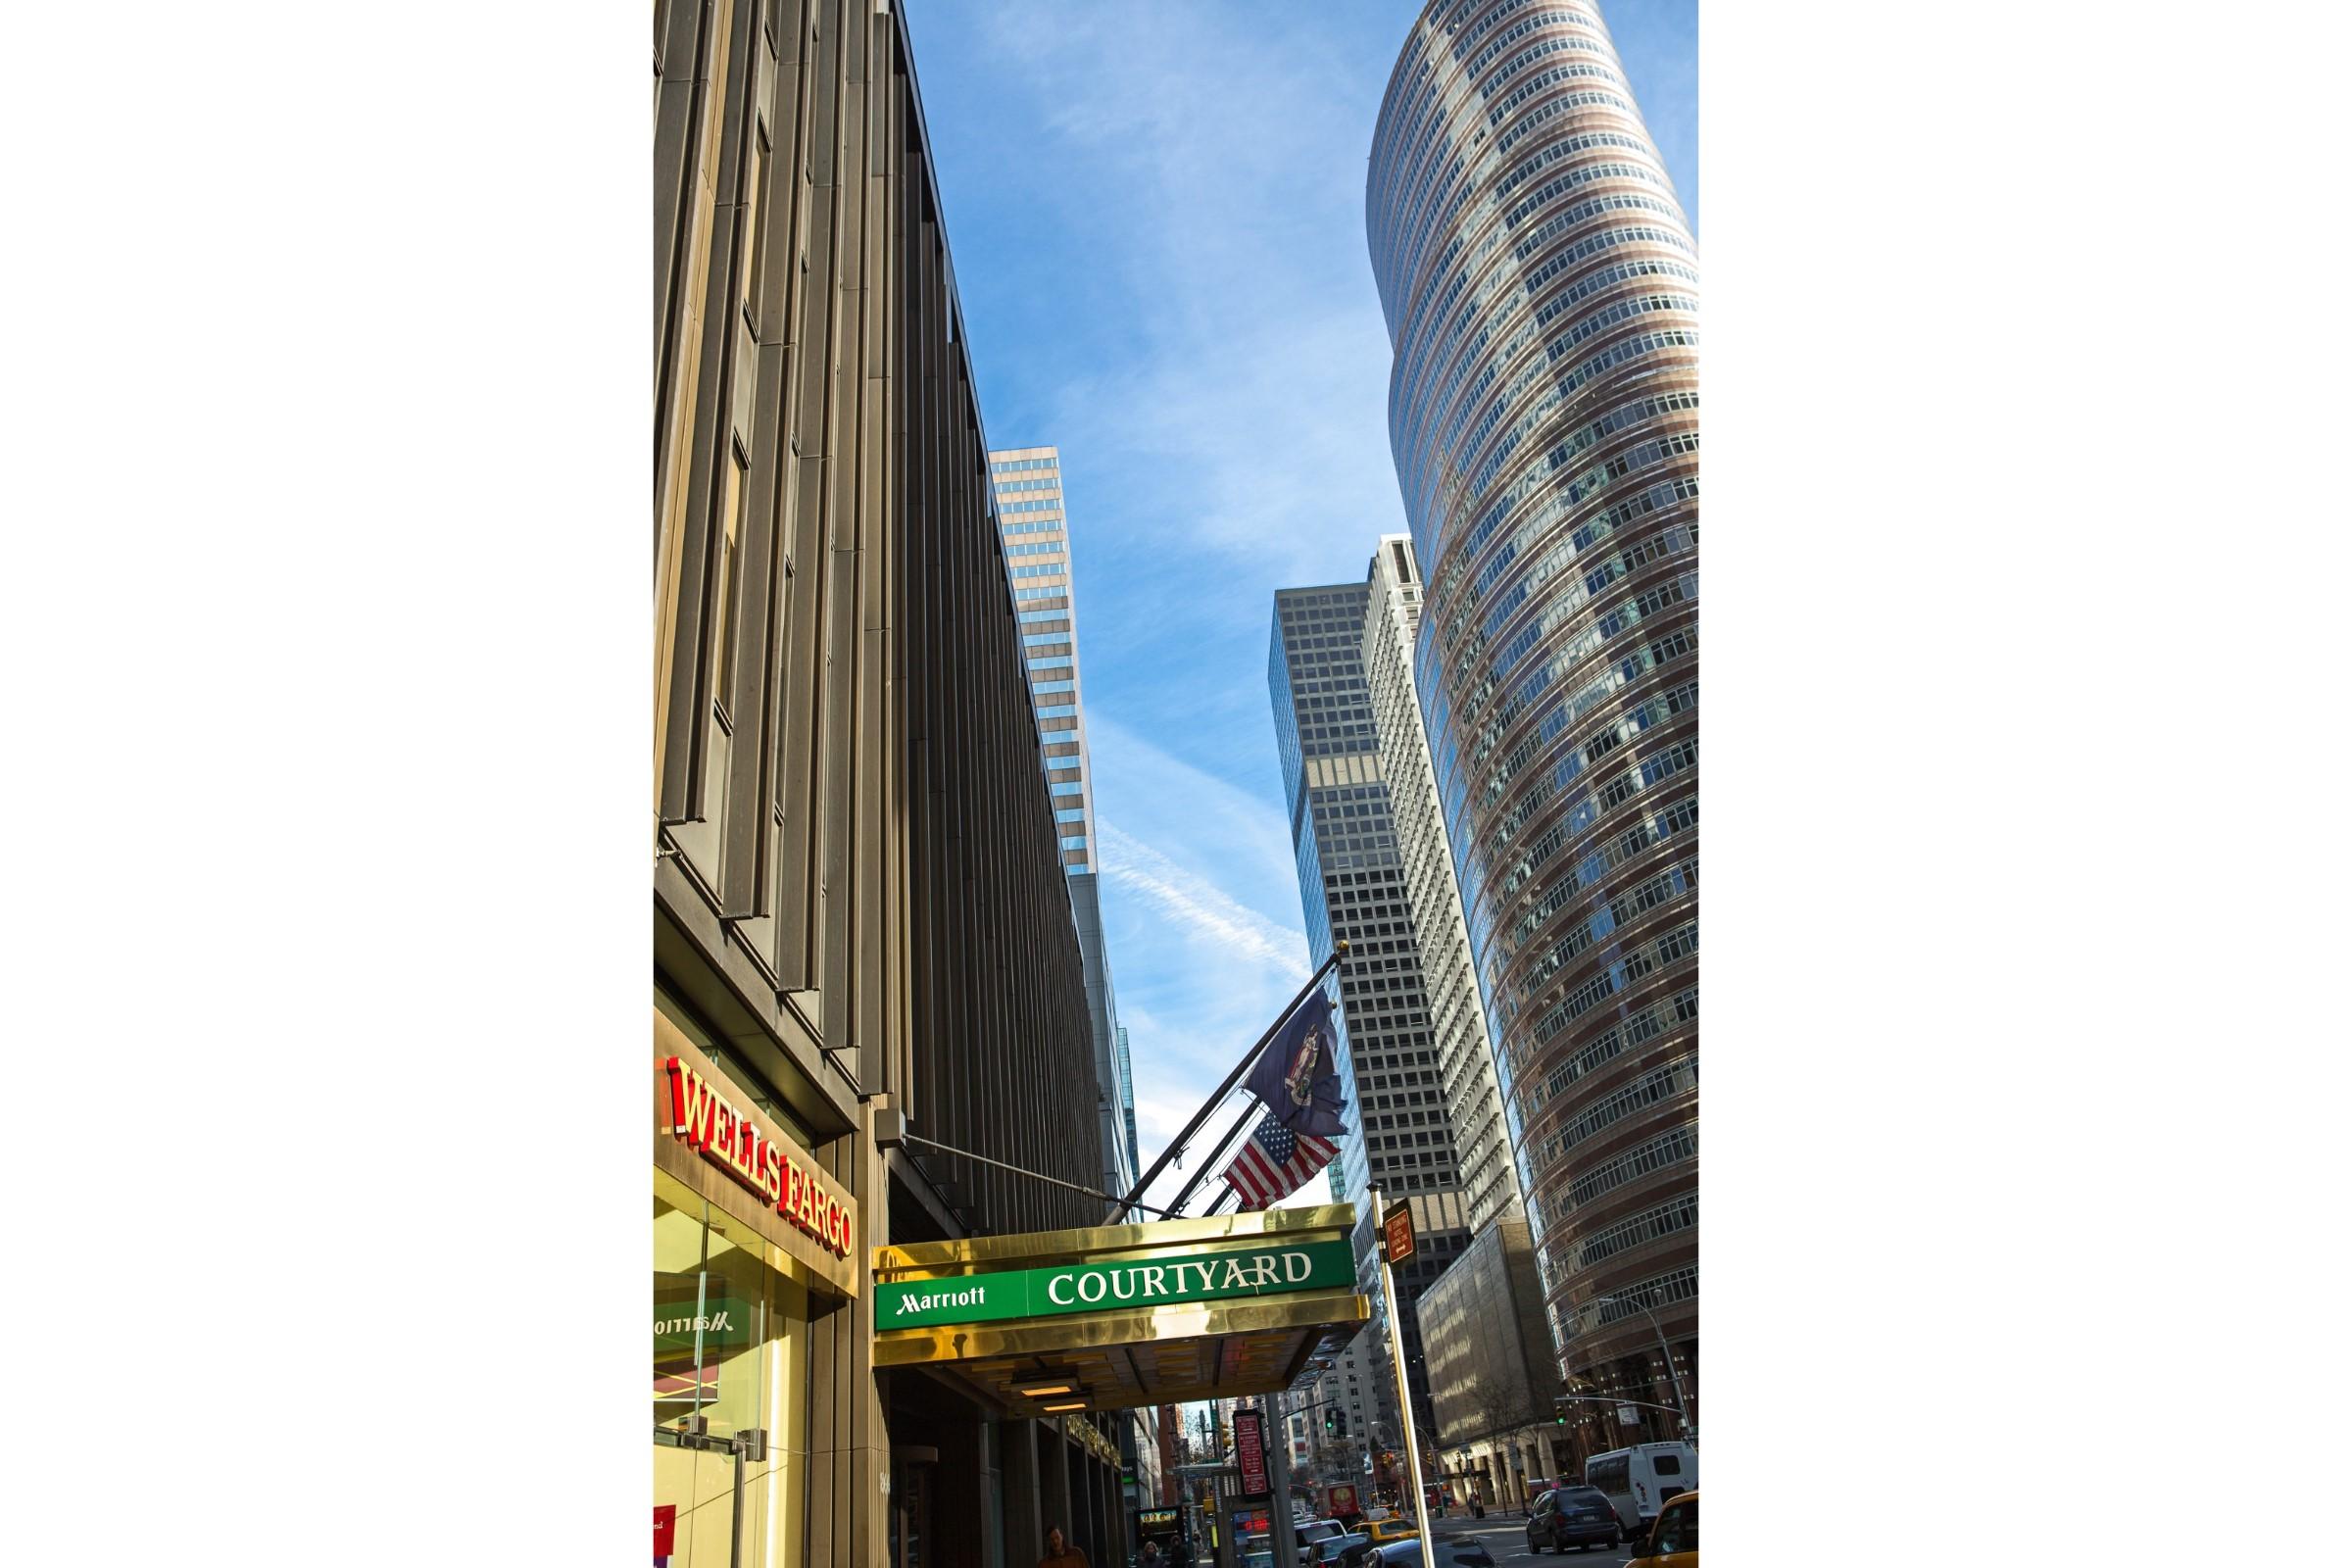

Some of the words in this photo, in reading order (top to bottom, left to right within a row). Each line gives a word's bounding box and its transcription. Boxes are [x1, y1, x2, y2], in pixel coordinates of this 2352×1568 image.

[669, 1056, 780, 1204] WELLS
[781, 1155, 852, 1257] FARGO
[896, 1286, 986, 1315] Marriott
[1048, 1251, 1312, 1305] COURTYARD
